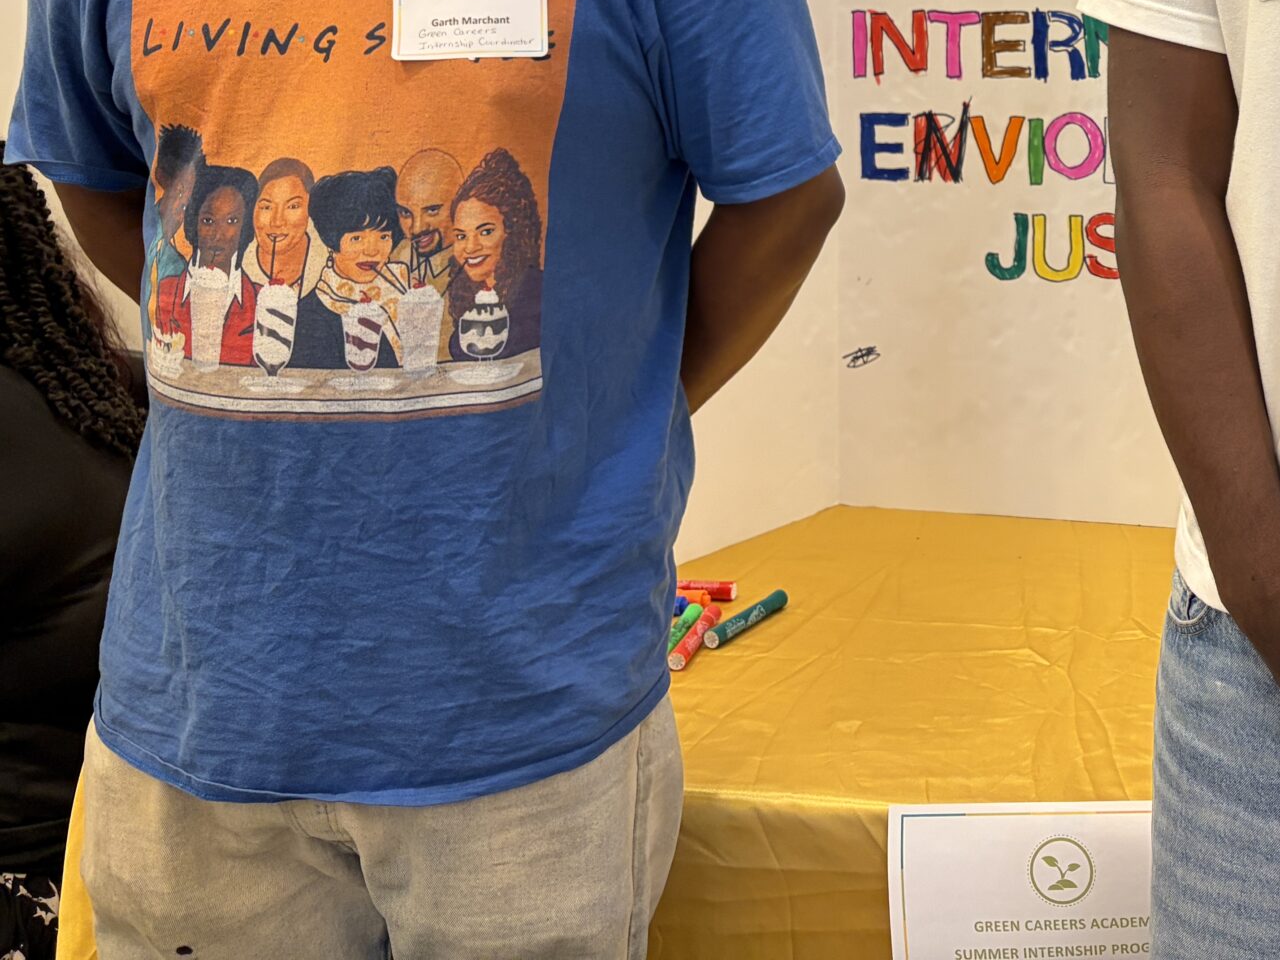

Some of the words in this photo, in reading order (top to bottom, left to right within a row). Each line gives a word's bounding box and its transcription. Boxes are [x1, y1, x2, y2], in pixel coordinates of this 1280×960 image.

[431, 17, 459, 28] Garth
[461, 16, 511, 26] Marchant
[418, 28, 448, 39] Green
[453, 27, 497, 37] Careers
[418, 39, 474, 51] Internship
[860, 100, 1116, 186] ENVIO
[973, 920, 1021, 933] GREEN
[1024, 918, 1087, 932] CAREERS
[954, 947, 1019, 960] SUMMER
[1023, 944, 1107, 959] INTERNSHIP
